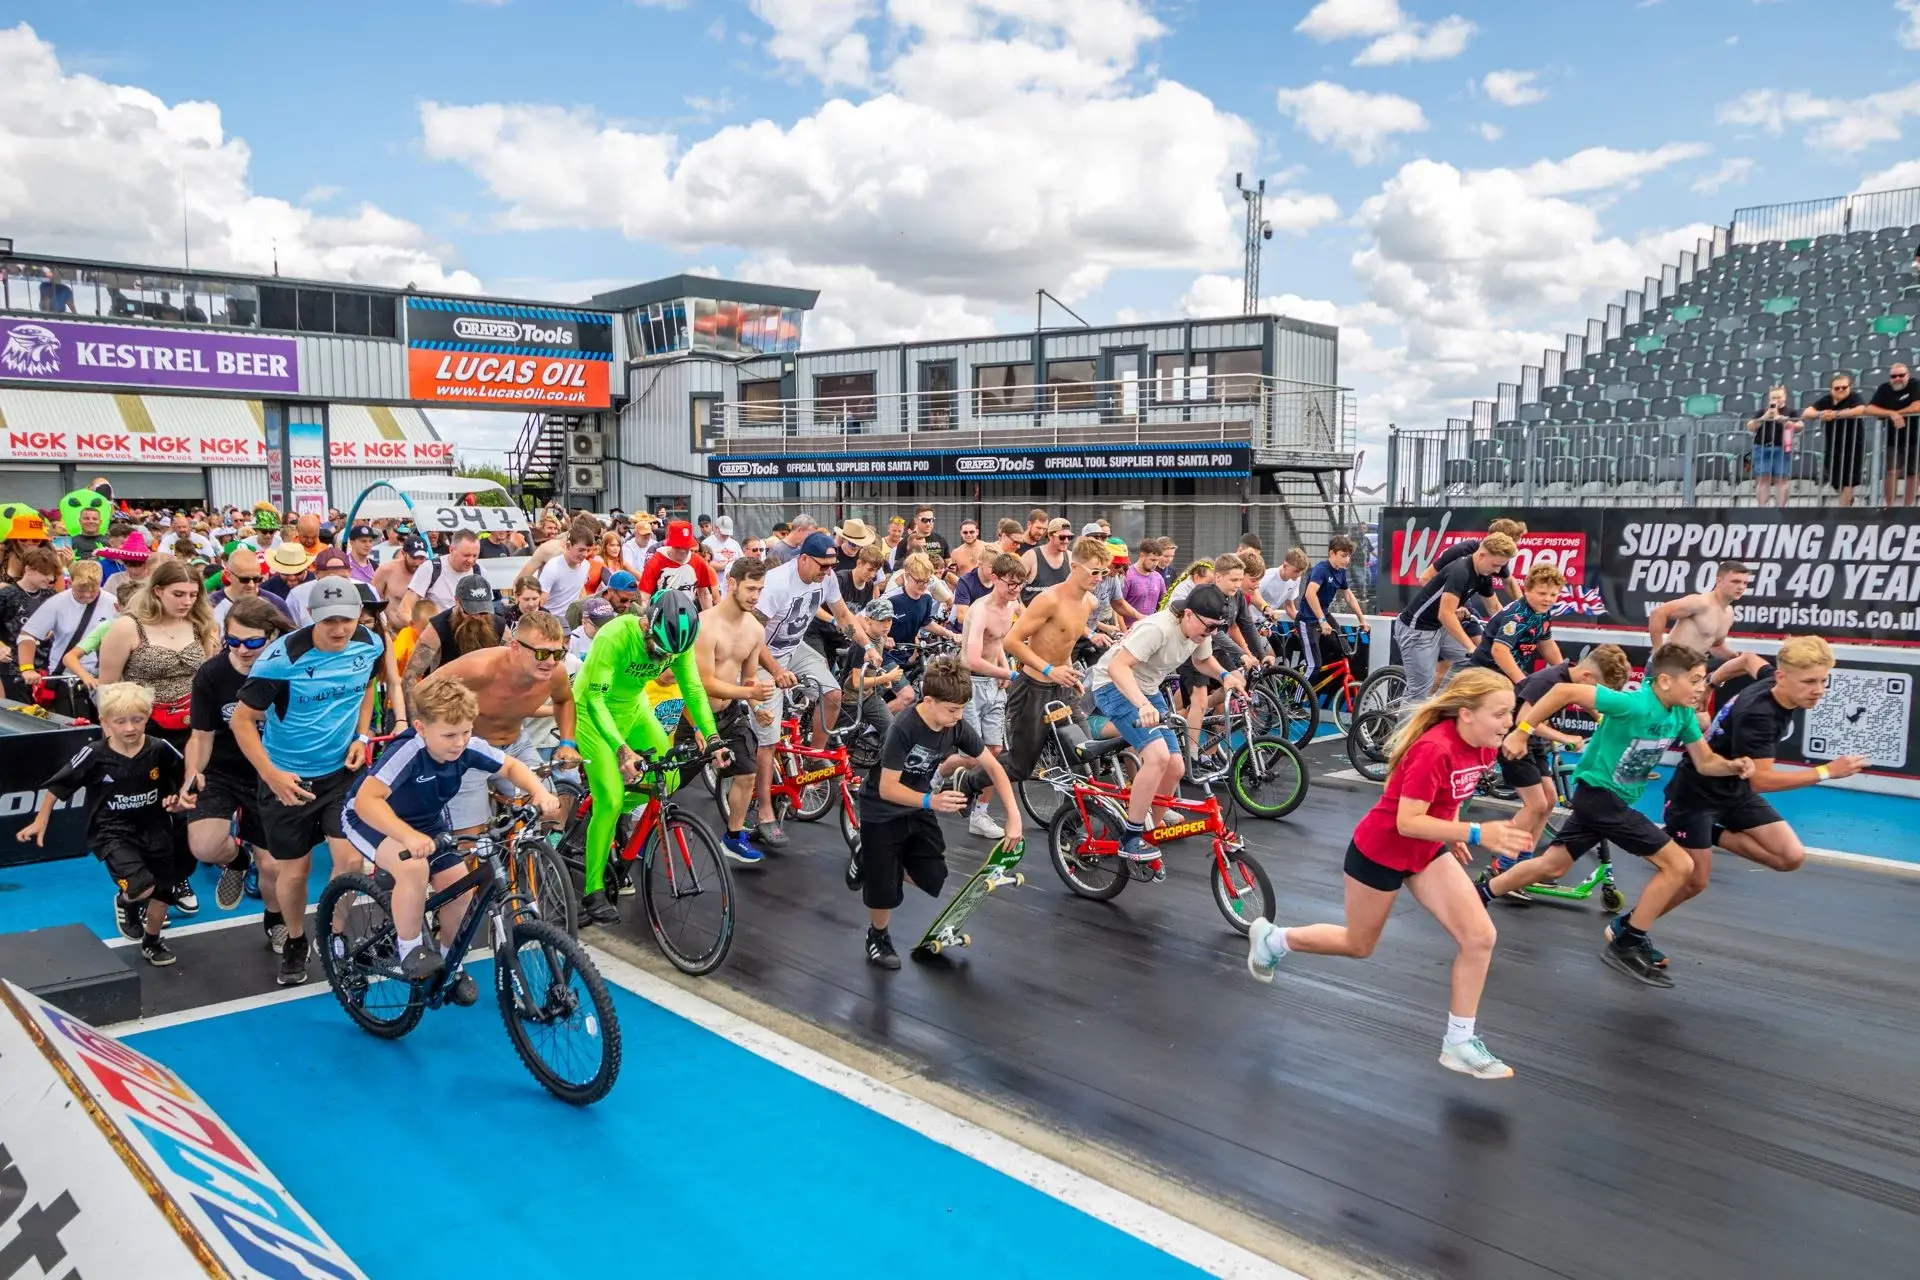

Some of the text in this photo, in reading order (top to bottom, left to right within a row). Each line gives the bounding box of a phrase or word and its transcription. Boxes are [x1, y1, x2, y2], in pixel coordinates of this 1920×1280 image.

[460, 322, 573, 345] DRAPER Tools
[76, 341, 290, 378] KESTREL BEER
[435, 355, 587, 388] LUCAS OIL
[436, 384, 586, 403] www.LucasOil.co.uk
[10, 432, 67, 450] NGK
[77, 433, 130, 451] NGK
[140, 436, 191, 453] NGK
[200, 438, 249, 455] NGK
[329, 441, 356, 457] GK
[364, 442, 406, 458] NGK
[413, 443, 454, 458] NGK
[293, 459, 321, 468] NGK
[722, 460, 929, 475] DRAPER Tools OFFICIAL TOOL SUPPLIER FOR SANTA POD
[960, 454, 1232, 471] DRAPER Tools OFFICIAL TOOL SUPPLIER FOR SANTA POD
[294, 475, 322, 484] NGK
[1546, 538, 1580, 546] PISTONS
[1619, 523, 1824, 560] SUPPORTING
[1628, 560, 1690, 593] FOR
[1695, 561, 1781, 597] OER
[1786, 563, 1835, 598] 40
[796, 766, 835, 785] CHOPPER
[108, 800, 146, 810] Viewer
[114, 793, 147, 804] Team
[1153, 820, 1206, 840] CHOPPER
